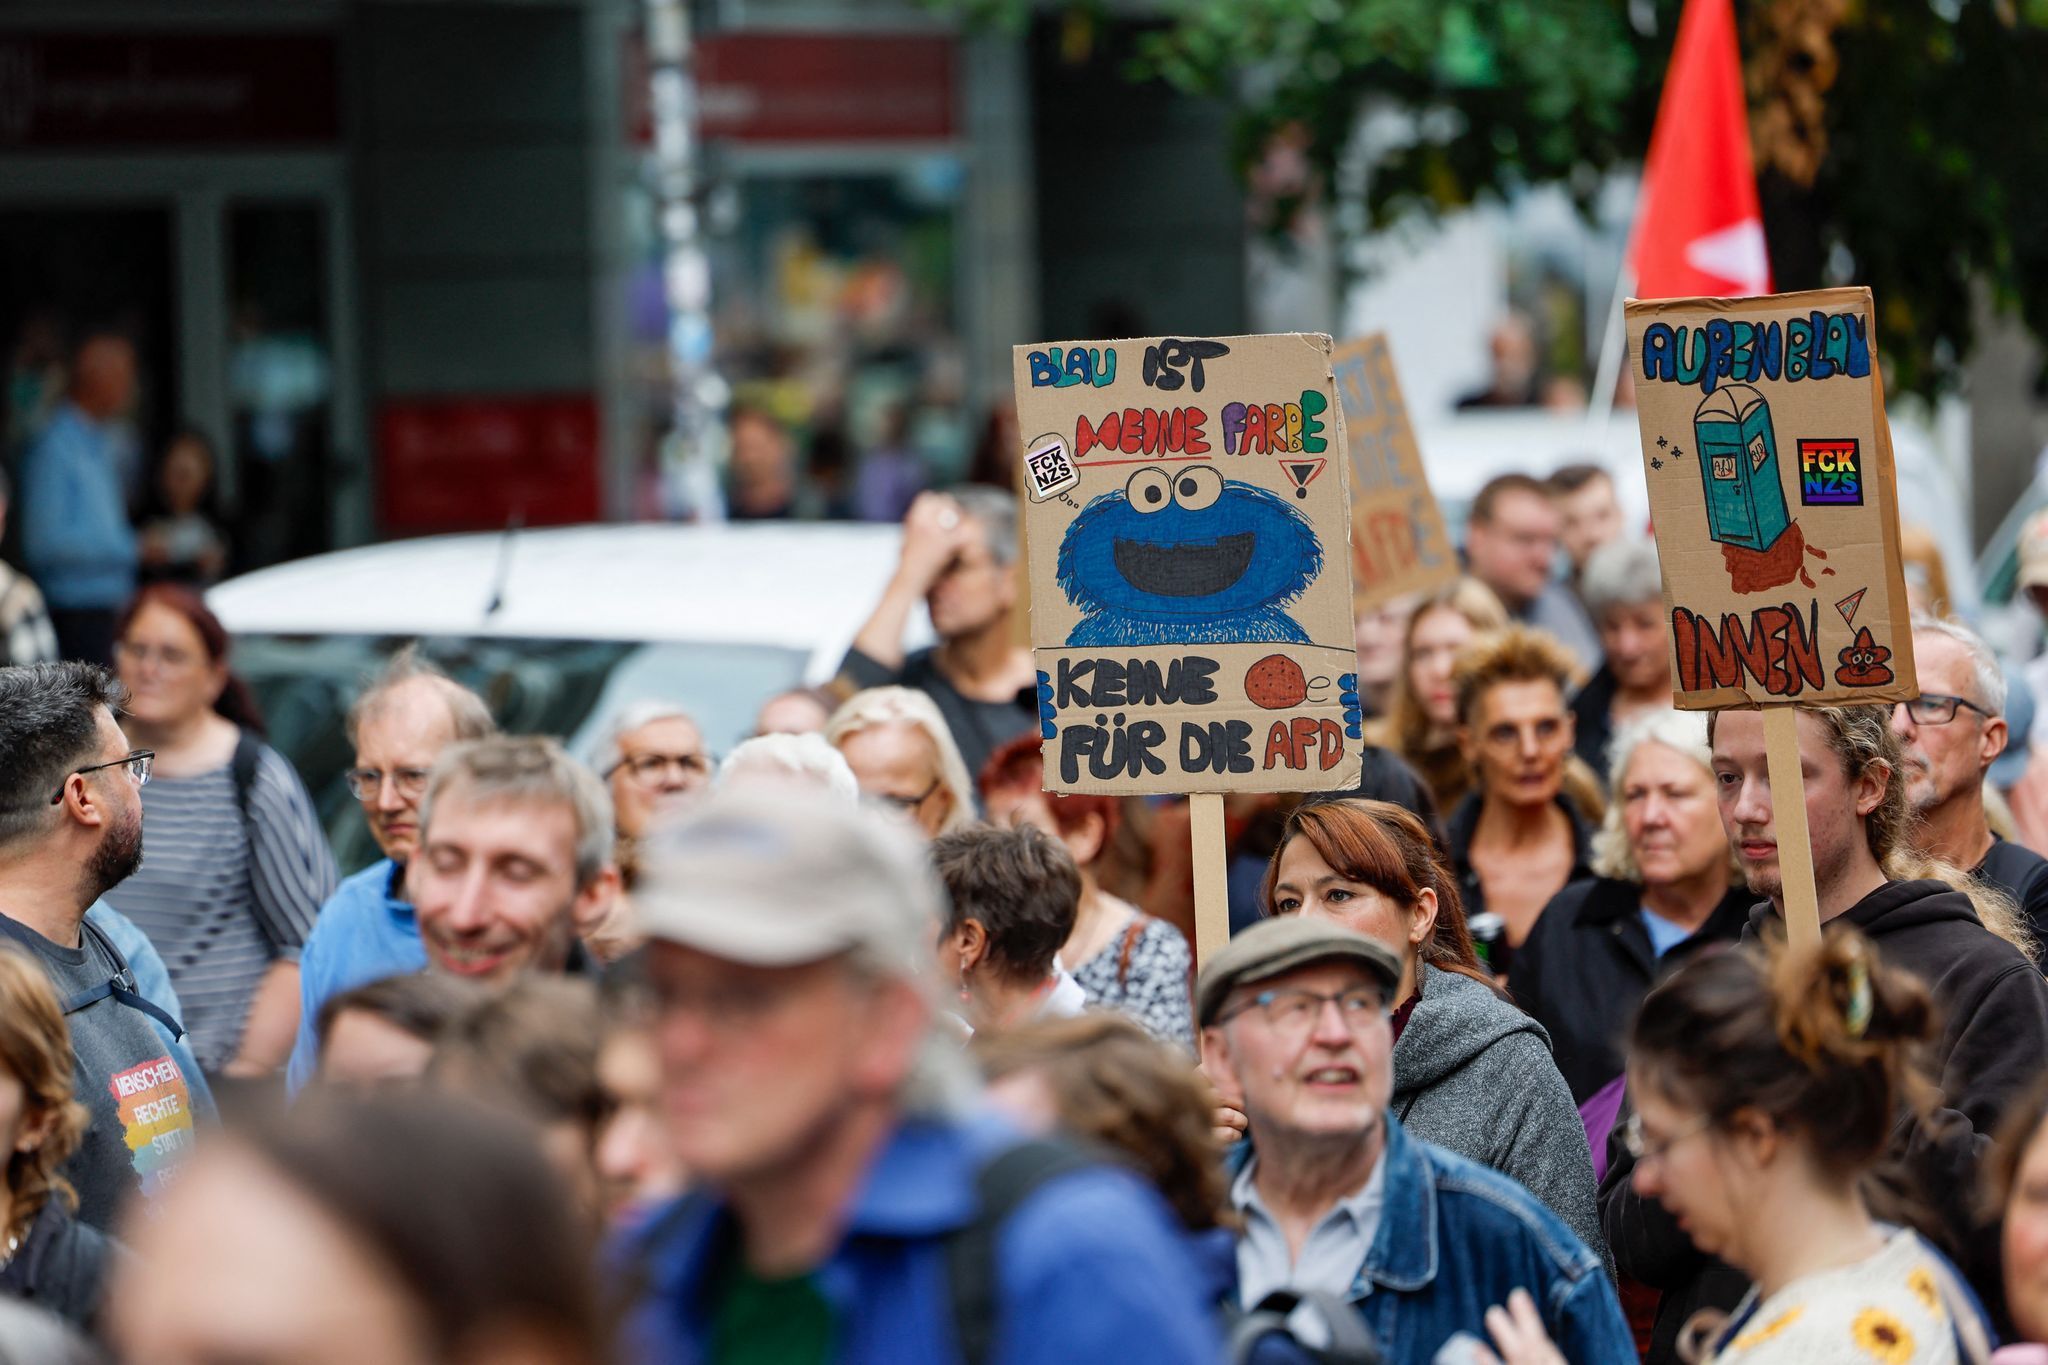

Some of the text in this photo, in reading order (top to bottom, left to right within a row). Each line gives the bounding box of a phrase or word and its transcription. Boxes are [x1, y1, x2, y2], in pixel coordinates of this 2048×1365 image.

[1027, 338, 1231, 392] BLAU IST
[1074, 390, 1328, 457] MEINE FARBE
[1030, 449, 1066, 475] FCK
[1035, 463, 1071, 488] NZS
[1803, 450, 1857, 472] FCK
[1804, 473, 1858, 495] NZS
[1672, 598, 1825, 697] INNEN
[1057, 656, 1220, 709] KEINE
[1060, 712, 1344, 784] FÜR DIE AFD
[115, 1060, 178, 1097] MENSCHEN
[132, 1094, 181, 1127] RECHTE
[151, 1127, 185, 1156] STATT
